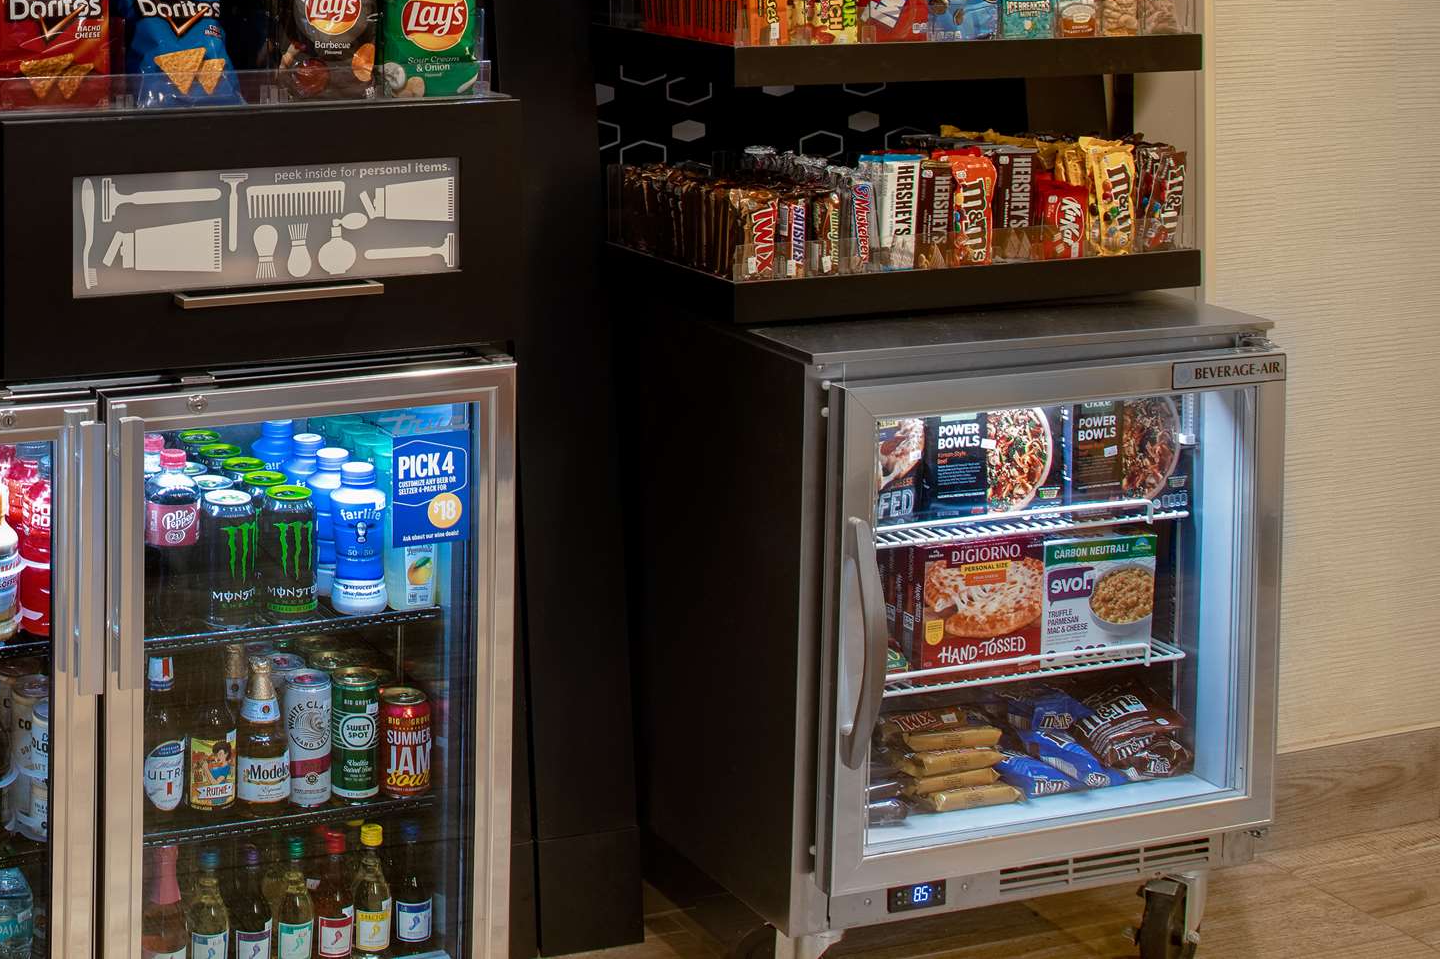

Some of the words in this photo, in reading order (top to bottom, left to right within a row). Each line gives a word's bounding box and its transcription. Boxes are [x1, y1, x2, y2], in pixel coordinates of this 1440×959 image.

[1006, 0, 1018, 15] ICE
[1018, 0, 1050, 13] BREAKERS
[406, 2, 465, 37] Lay's
[75, 31, 101, 39] CHEESE
[314, 40, 351, 50] Barbecue
[407, 56, 429, 64] Sour
[430, 55, 460, 64] Cream
[424, 63, 451, 72] Onion
[274, 169, 302, 183] peek
[304, 167, 338, 179] inside
[340, 167, 357, 178] for
[359, 164, 413, 179] personal
[414, 162, 452, 174] items.
[1010, 155, 1032, 229] HERSHEY'S
[895, 165, 915, 236] HERSHEY'S
[932, 175, 953, 244] HERSHEY'S
[751, 199, 779, 274] TWIX
[1194, 361, 1282, 380] BEVERAGE-AIR
[1078, 415, 1117, 429] POWER
[938, 423, 980, 437] POWER
[1077, 427, 1117, 441] BOWLS
[937, 436, 981, 450] BOWLS
[398, 452, 440, 480] PICK
[441, 450, 455, 474] 4
[398, 479, 425, 489] CUSTOMIZE
[426, 477, 436, 486] ANY
[437, 476, 448, 485] BEER
[449, 475, 456, 483] OR
[398, 486, 418, 496] SELTZER
[437, 483, 448, 491] FOR
[165, 511, 195, 529] Pepper
[175, 509, 188, 521] Dr
[340, 508, 382, 521] fairlife
[402, 534, 411, 542] Ask
[412, 532, 426, 541] about
[426, 532, 434, 540] our
[1054, 547, 1088, 560] CARBON
[1089, 543, 1130, 556] NEUTRAL!
[964, 564, 995, 573] PERSONAL
[996, 562, 1009, 570] SIZE
[1048, 609, 1073, 618] TRUFFLE
[1047, 616, 1079, 626] PARMESAN
[1047, 625, 1061, 634] MAC
[1061, 625, 1066, 633] &
[1066, 622, 1088, 632] CHEESE
[937, 636, 1027, 665] HAND-TOSSED
[288, 703, 304, 730] WHITE
[388, 716, 399, 726] BIG
[891, 712, 937, 731] TWIX
[387, 727, 431, 746] SUMMER
[386, 741, 432, 776] JAM
[206, 784, 228, 797] RUTHIE
